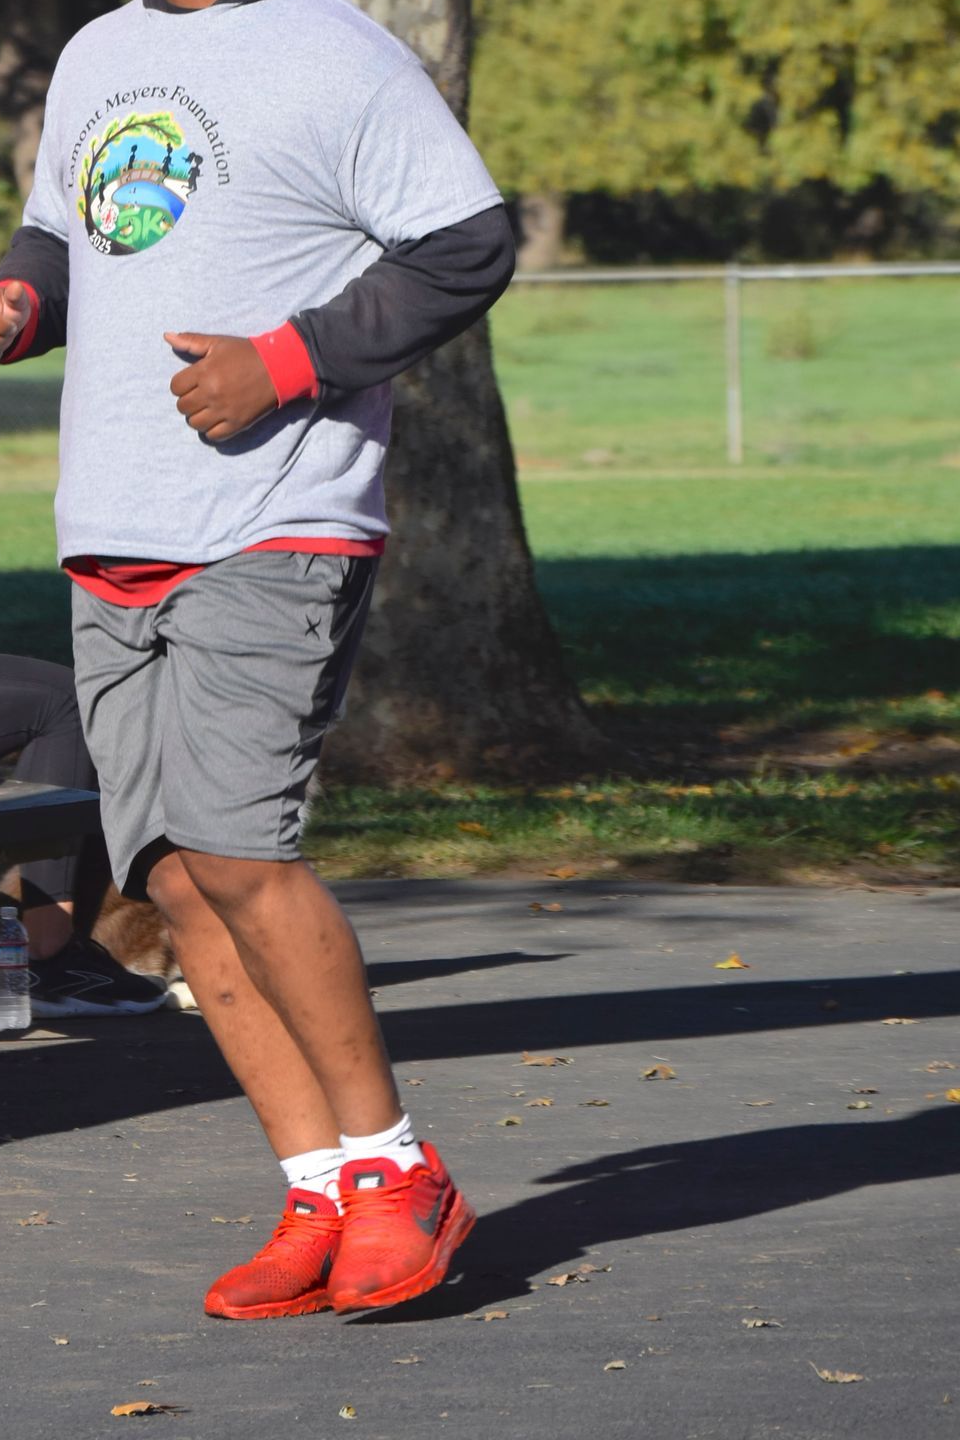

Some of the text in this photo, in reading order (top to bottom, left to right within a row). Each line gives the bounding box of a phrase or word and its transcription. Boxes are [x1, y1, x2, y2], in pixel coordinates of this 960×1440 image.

[67, 84, 231, 189] Lamont Meyers Foundation
[88, 228, 113, 255] 2025
[115, 208, 164, 246] 5K
